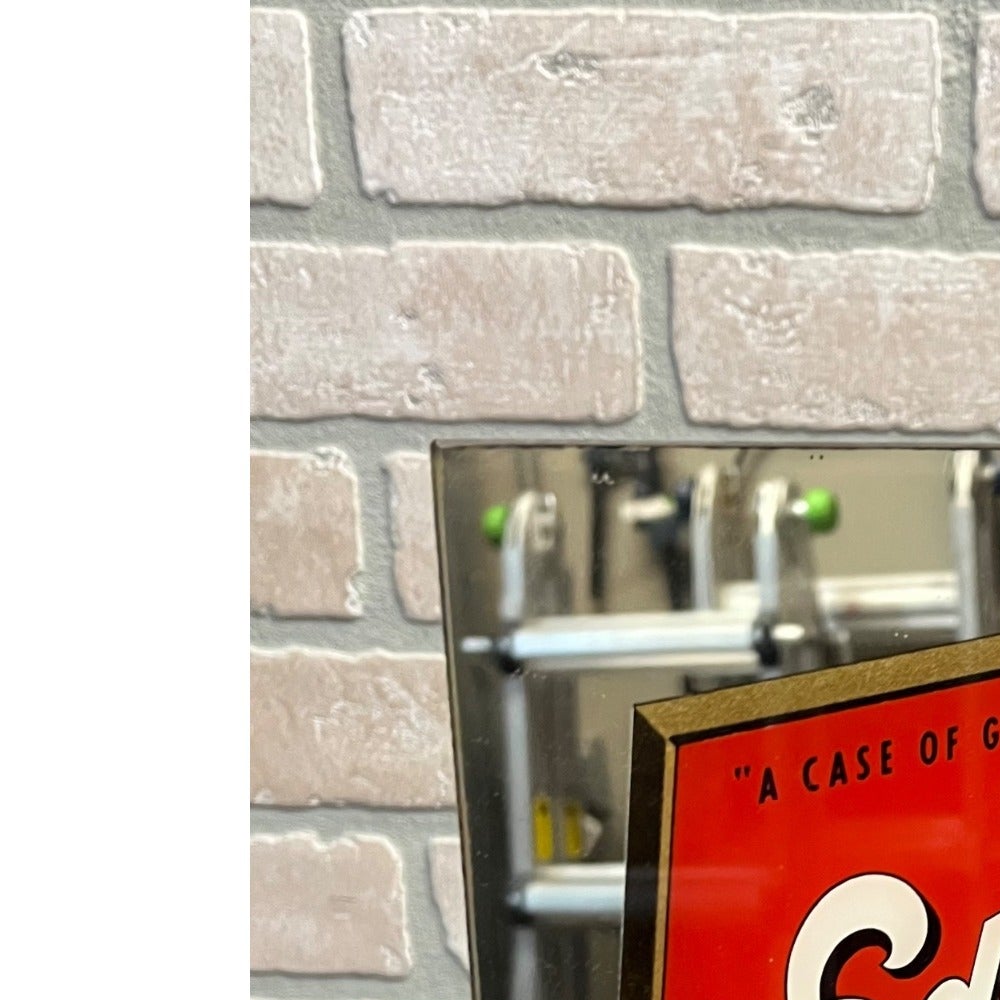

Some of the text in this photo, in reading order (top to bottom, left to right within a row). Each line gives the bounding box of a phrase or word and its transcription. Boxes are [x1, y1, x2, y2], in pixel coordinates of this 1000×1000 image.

[734, 765, 778, 804] "A
[803, 740, 893, 792] CASE
[920, 725, 958, 765] OF
